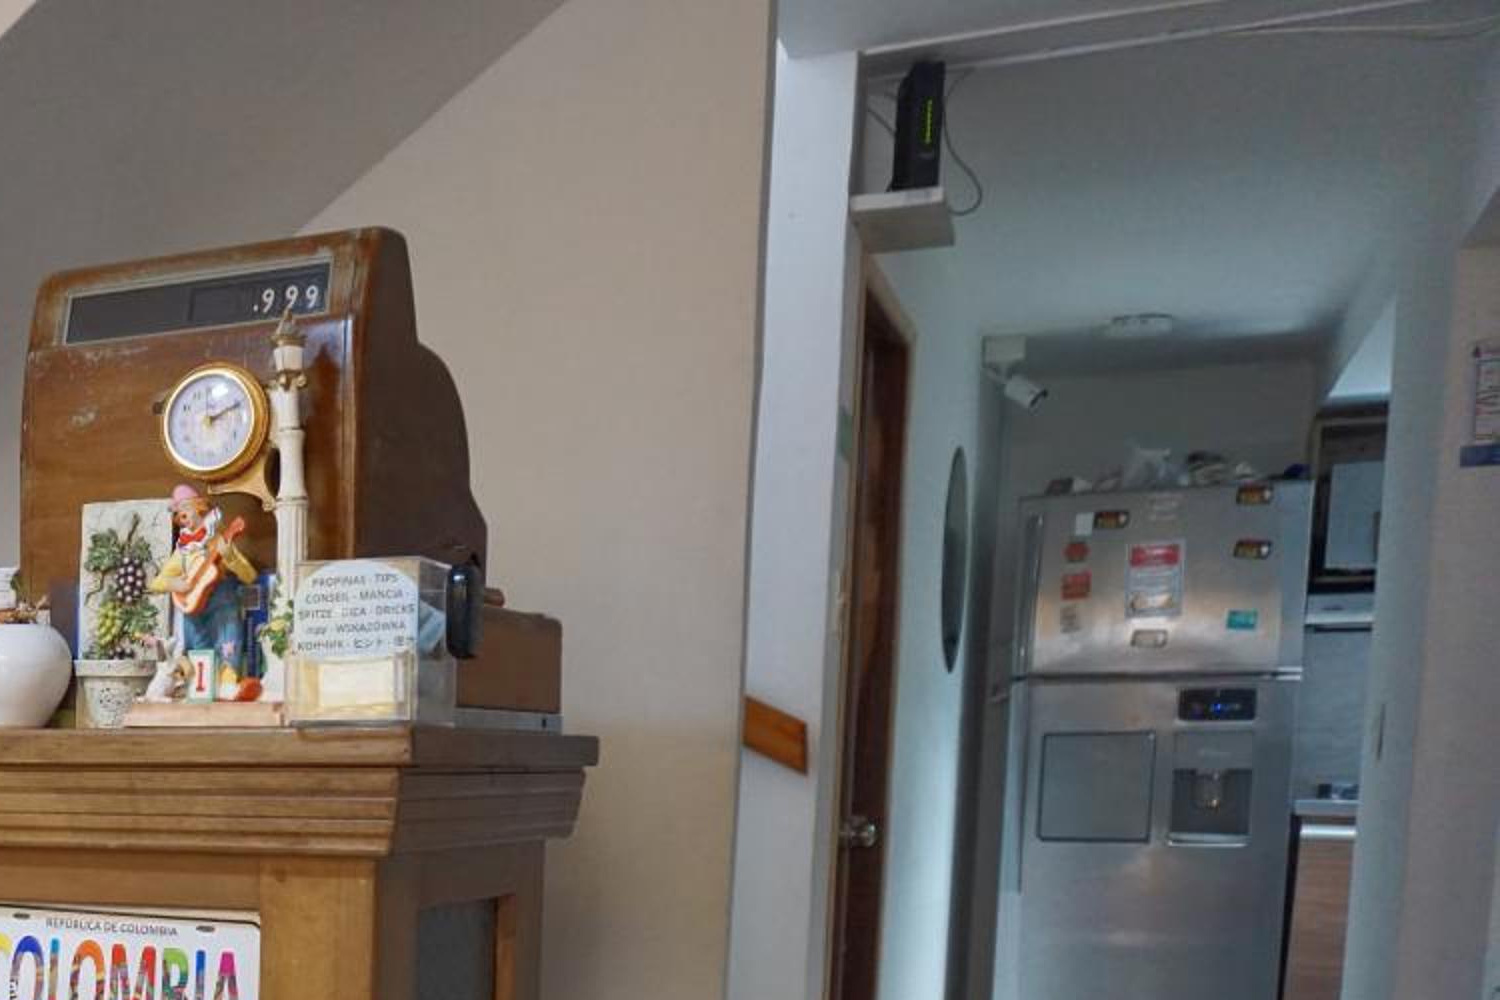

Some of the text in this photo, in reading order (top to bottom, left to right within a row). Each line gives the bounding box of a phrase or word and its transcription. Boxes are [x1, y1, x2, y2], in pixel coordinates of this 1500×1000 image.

[312, 573, 398, 588] PROPINAS TIPS
[104, 921, 118, 933] DE
[120, 923, 178, 936] COLOMBIA
